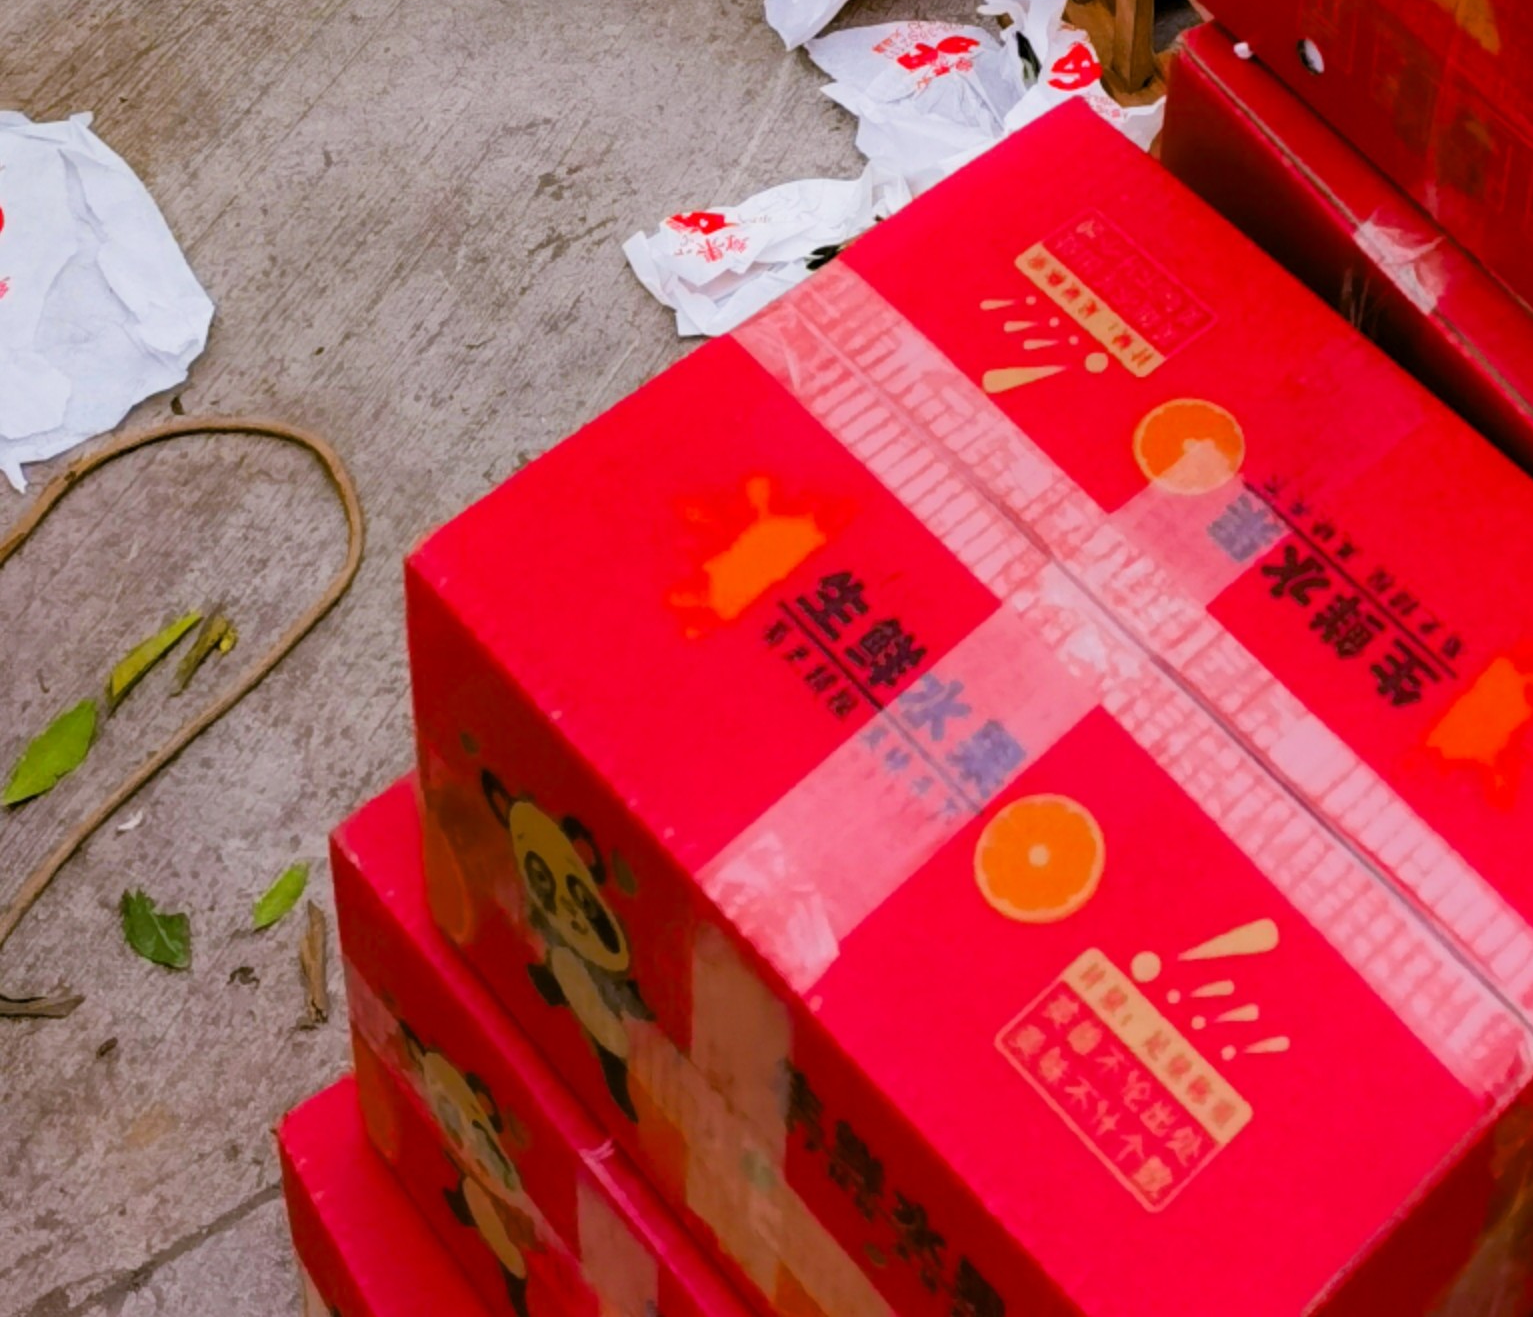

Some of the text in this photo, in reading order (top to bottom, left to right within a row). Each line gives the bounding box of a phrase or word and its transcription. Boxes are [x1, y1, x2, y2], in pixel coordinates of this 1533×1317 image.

[796, 571, 1027, 800] 生鲜水果
[1207, 493, 1441, 708] 生鲜水果
